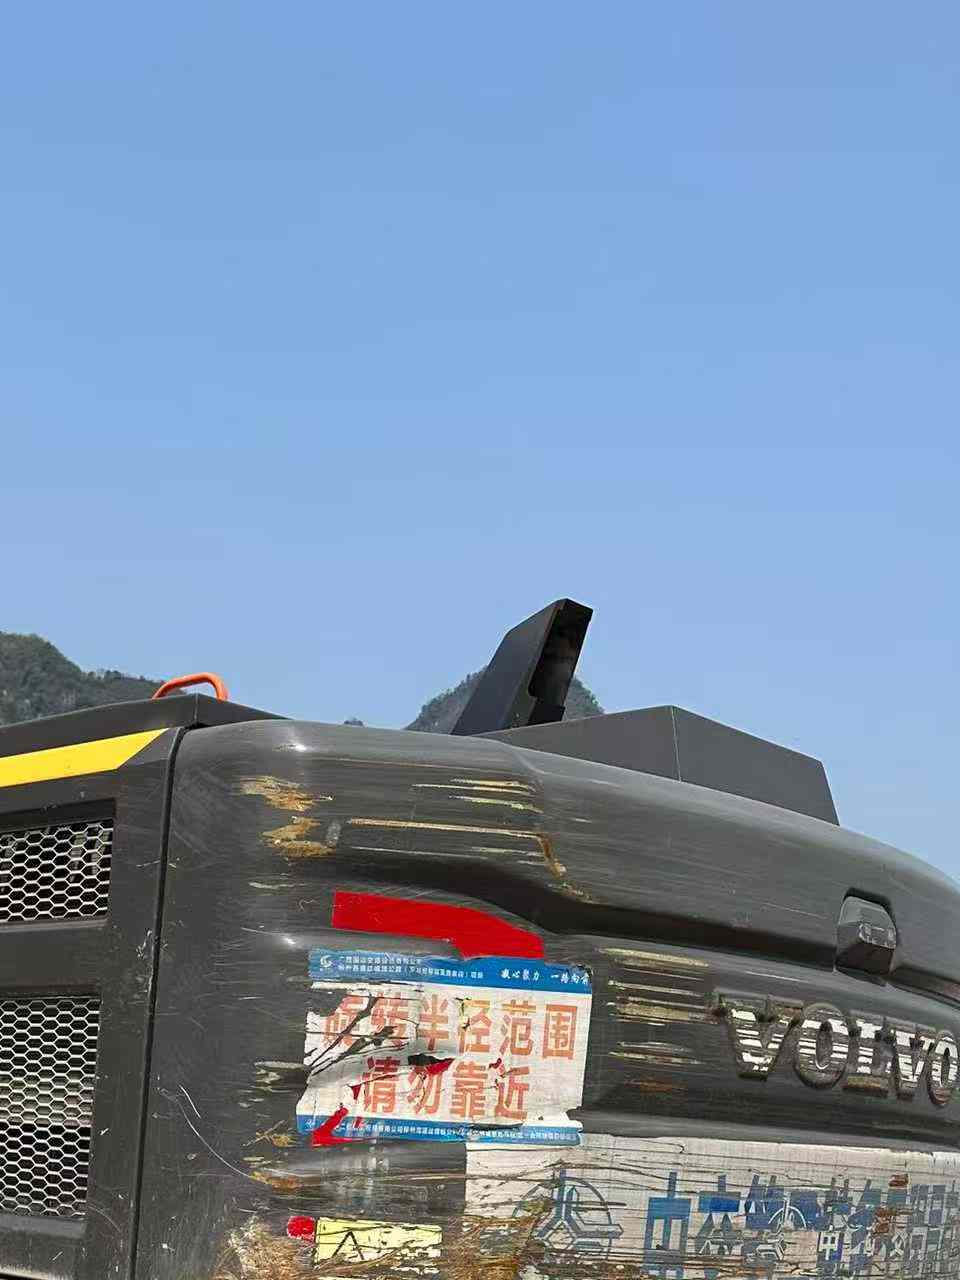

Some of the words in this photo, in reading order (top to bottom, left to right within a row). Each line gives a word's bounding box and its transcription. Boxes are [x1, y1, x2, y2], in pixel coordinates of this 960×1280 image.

[361, 1056, 531, 1121] 请勿靠近
[722, 990, 959, 1105] VOLVO
